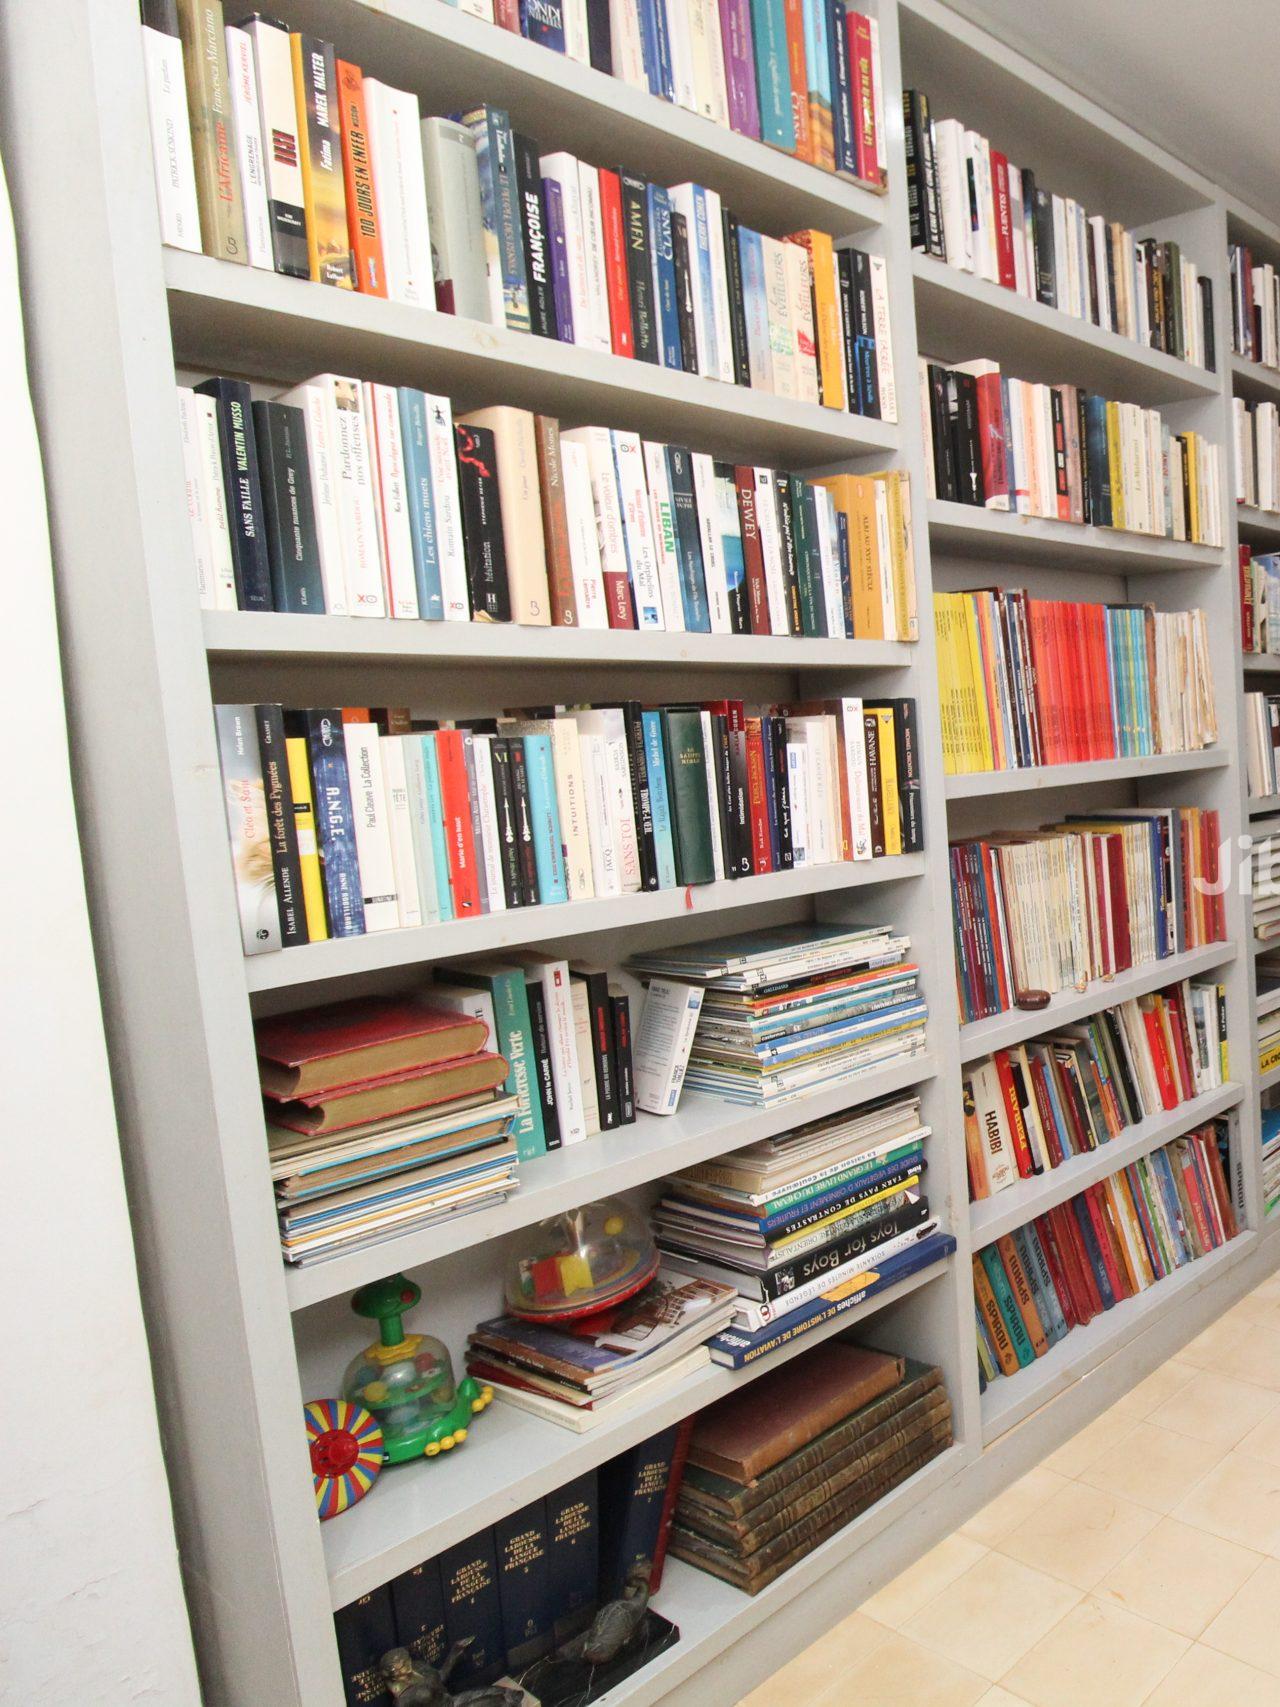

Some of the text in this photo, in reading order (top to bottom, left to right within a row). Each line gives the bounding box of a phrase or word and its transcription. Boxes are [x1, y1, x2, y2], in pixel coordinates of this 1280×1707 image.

[313, 52, 326, 91] HALTER
[316, 94, 329, 128] MAREK
[352, 131, 366, 165] ENFER
[357, 168, 368, 180] EN
[359, 182, 372, 216] JOURS
[527, 191, 547, 283] FRANÇOISE
[341, 416, 352, 480] Pardonnez
[352, 415, 363, 462] offenses
[232, 401, 255, 537] SANS FAILLE VALENTIN MUSSO
[288, 466, 296, 485] Grey
[550, 459, 559, 487] Nicole
[420, 477, 435, 564] Les chiens muets
[660, 502, 674, 554] LIBAN
[741, 488, 757, 541] DEWEY
[295, 526, 303, 561] Cinquante
[615, 576, 625, 600] Marc
[270, 761, 283, 799] Pygmées
[272, 801, 282, 817] des
[275, 818, 286, 839] forêt
[277, 840, 287, 854] La
[281, 867, 293, 904] ALLENDE
[287, 907, 296, 935] ISABEL
[510, 1031, 523, 1059] Verte
[984, 1110, 1003, 1155] HABIBI
[784, 1175, 903, 1234] TARN PAYS DE CONTRASTES
[803, 1251, 840, 1277] Boys
[844, 1240, 867, 1257] for
[826, 1308, 837, 1319] DE
[836, 1290, 866, 1312] affiches
[985, 1300, 1008, 1351] SPIROU
[1004, 1295, 1026, 1346] SPIROU
